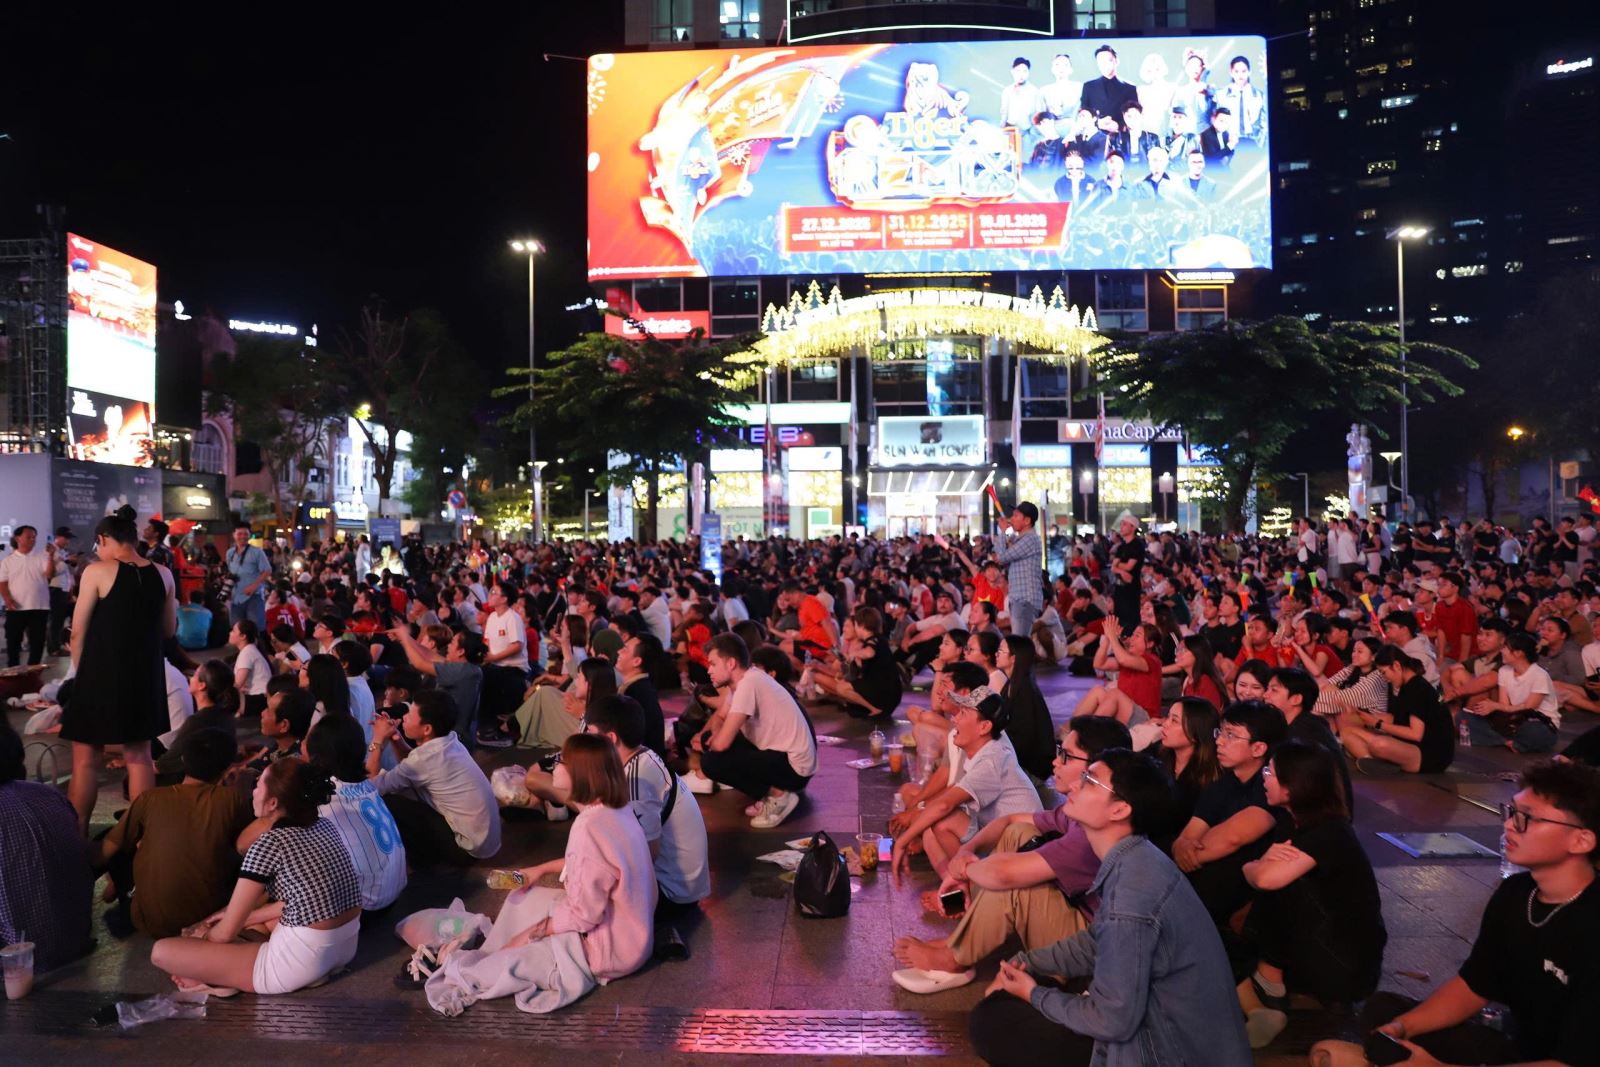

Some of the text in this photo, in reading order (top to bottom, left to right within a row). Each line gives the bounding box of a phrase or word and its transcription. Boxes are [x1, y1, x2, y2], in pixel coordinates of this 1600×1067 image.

[884, 112, 967, 148] Tiger
[888, 213, 968, 230] 31.12.2025
[623, 318, 692, 335] Eirates
